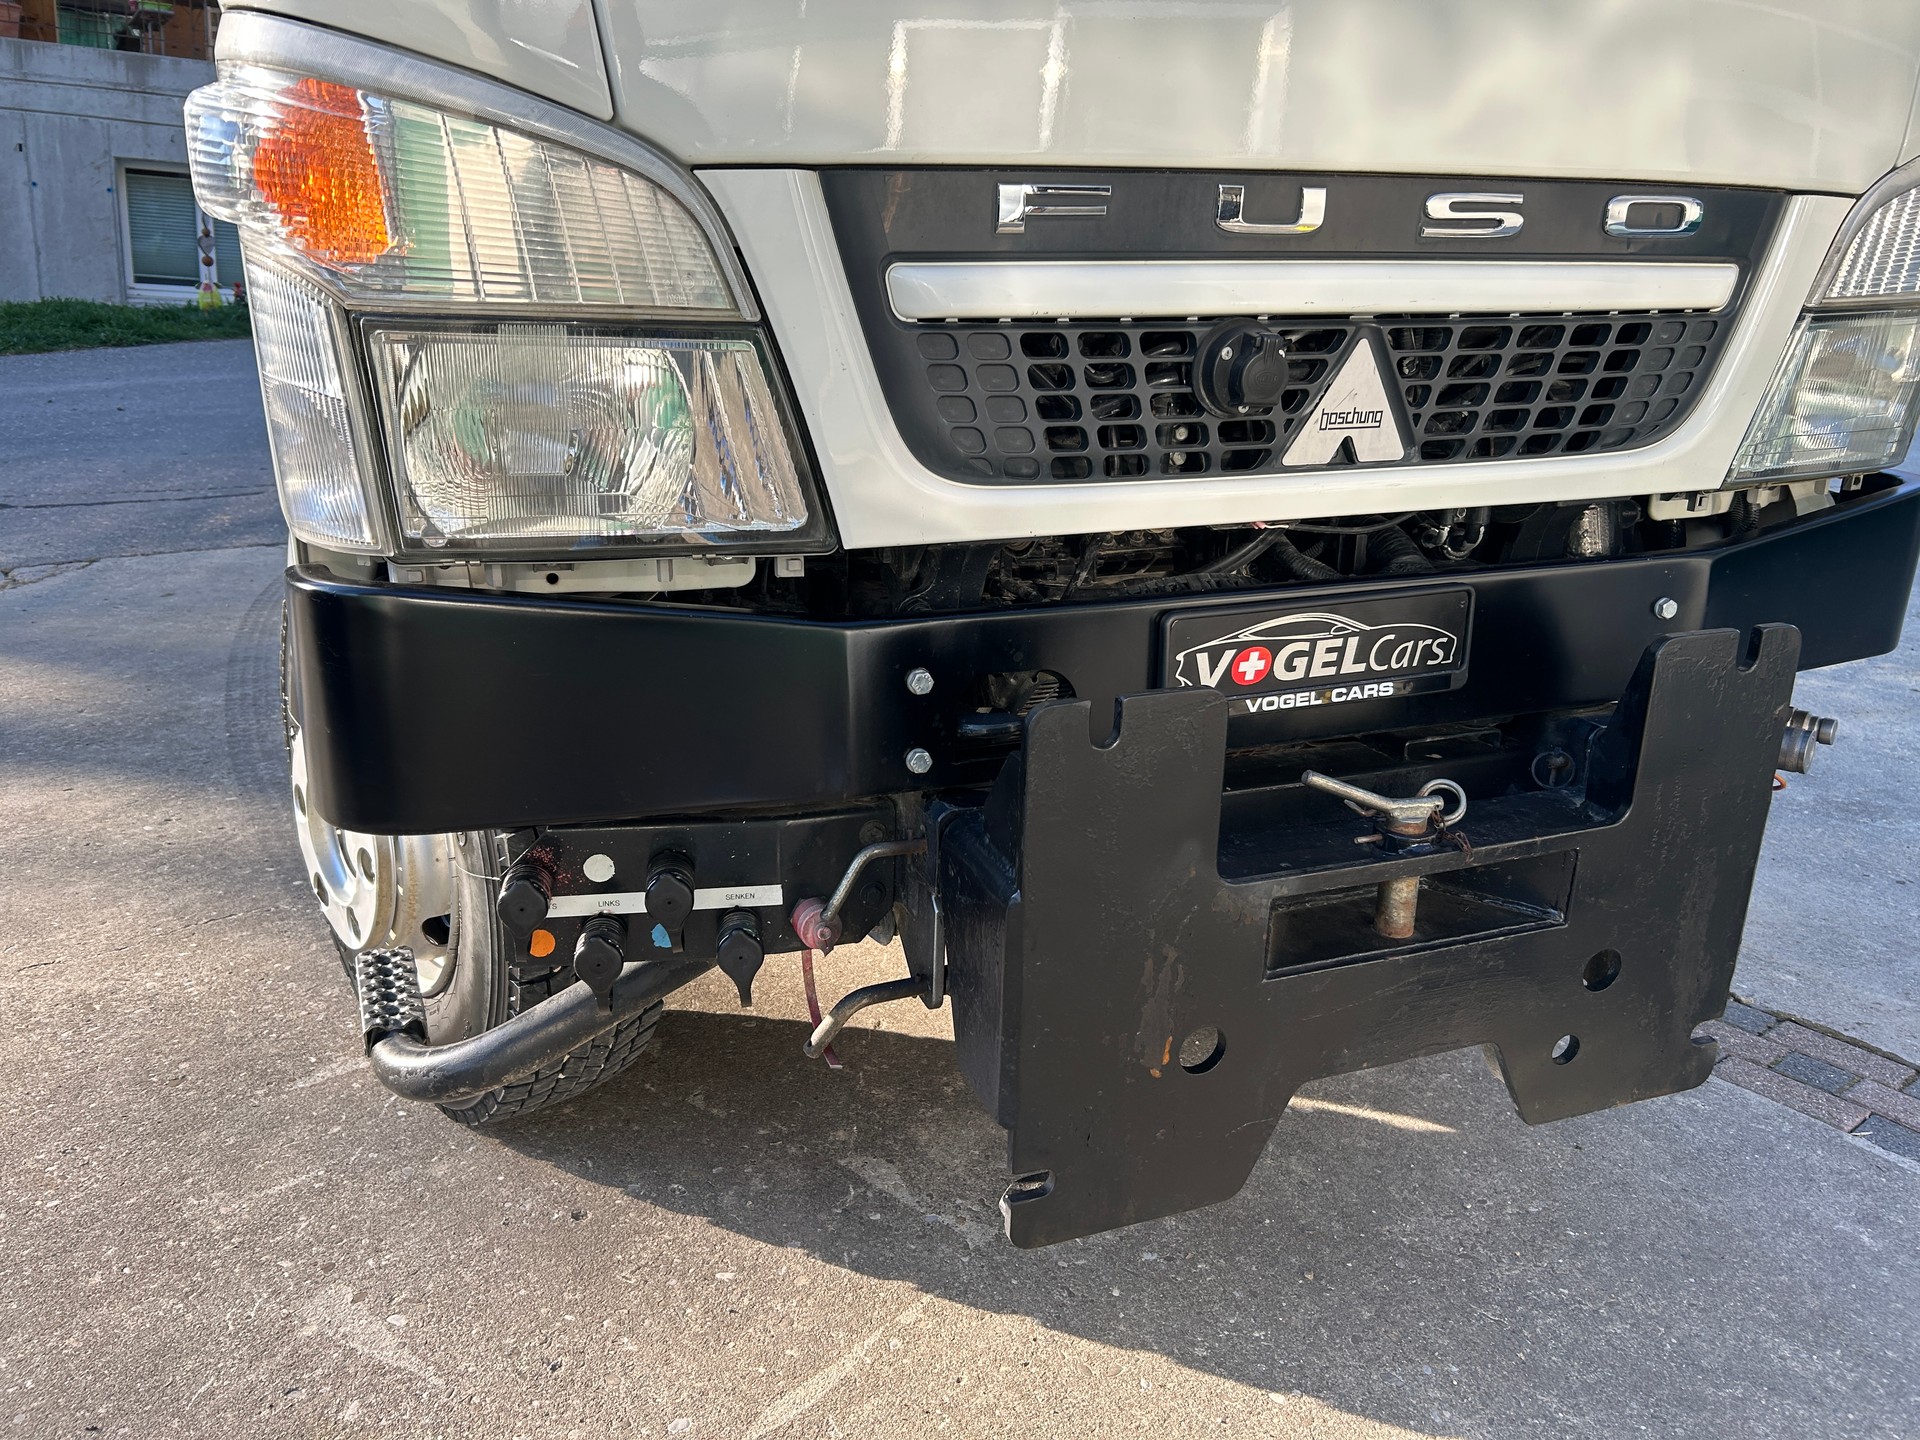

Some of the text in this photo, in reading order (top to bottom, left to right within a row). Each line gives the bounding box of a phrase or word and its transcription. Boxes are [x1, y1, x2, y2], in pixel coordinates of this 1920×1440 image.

[995, 183, 1704, 239] FUSO
[1319, 406, 1384, 431] boschung
[1245, 681, 1394, 714] VOGEL CARS
[597, 899, 621, 908] LINKS
[725, 892, 756, 901] SENKEN
